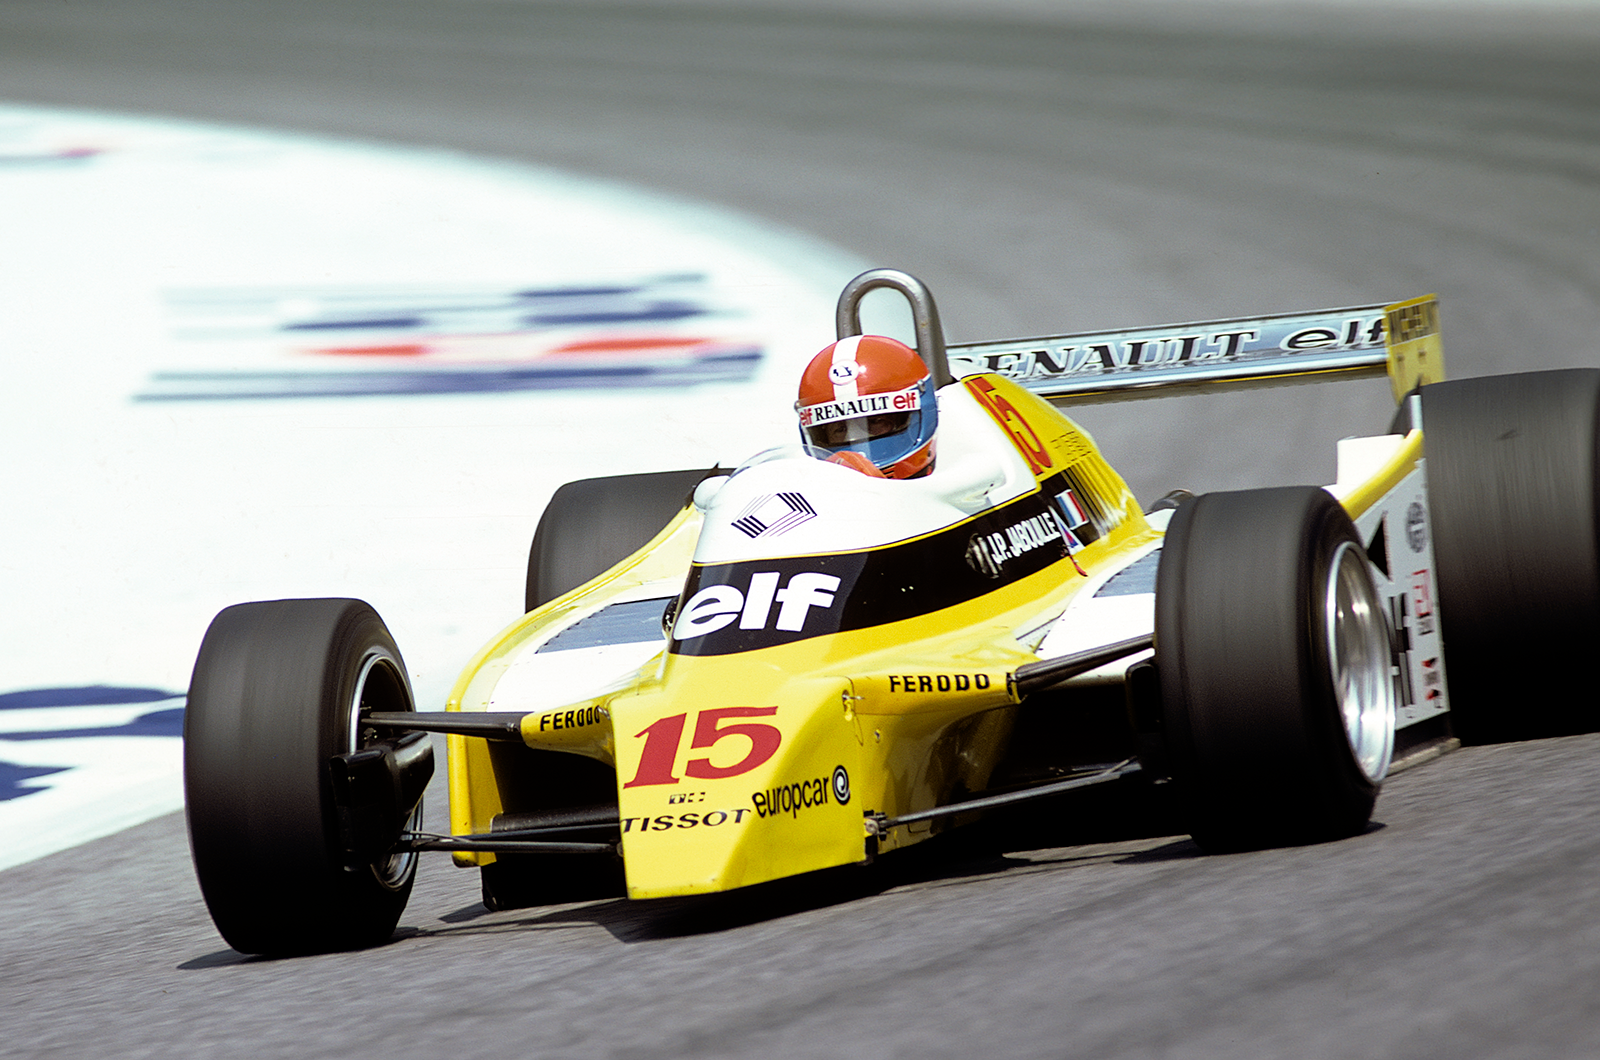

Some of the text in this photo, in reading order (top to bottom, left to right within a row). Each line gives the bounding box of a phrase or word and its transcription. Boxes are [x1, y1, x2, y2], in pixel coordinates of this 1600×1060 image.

[955, 329, 1260, 376] ENAULT
[814, 395, 889, 421] RENAULT
[893, 392, 916, 410] elf
[672, 571, 842, 641] elf
[888, 673, 991, 693] FERODO
[623, 705, 783, 790] 15
[751, 776, 830, 819] europcar
[620, 808, 752, 834] TISSOT
